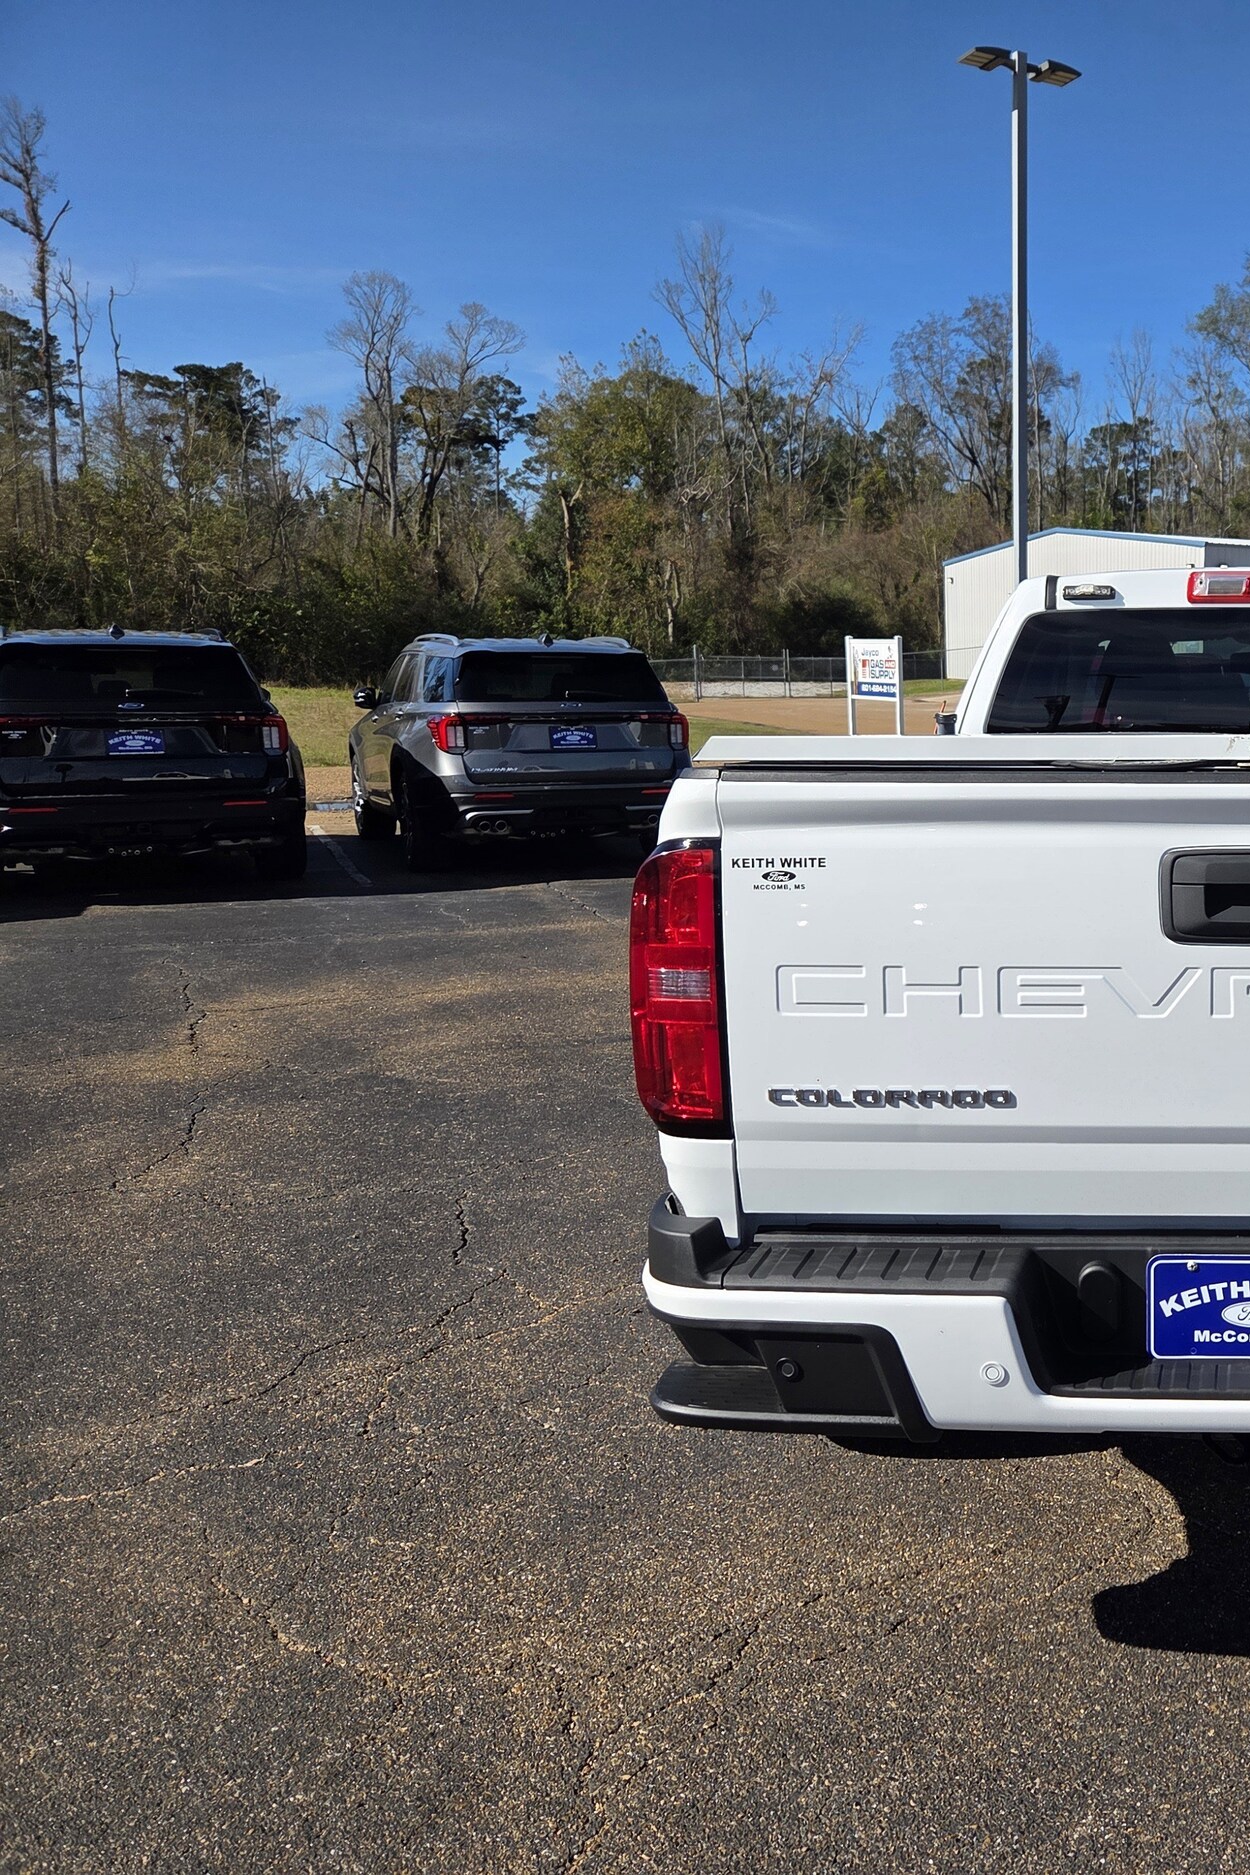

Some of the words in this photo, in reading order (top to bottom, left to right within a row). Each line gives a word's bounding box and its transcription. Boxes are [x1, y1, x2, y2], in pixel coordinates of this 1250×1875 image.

[870, 659, 884, 669] GAS
[870, 669, 896, 680] SUPPLY
[108, 735, 133, 745] KEITH
[134, 735, 162, 744] WHITE
[731, 858, 775, 868] KEITH
[779, 857, 827, 868] WHITE
[767, 871, 791, 881] Ford
[767, 1086, 1018, 1109] COLORADO
[1159, 1280, 1250, 1318] KEITH
